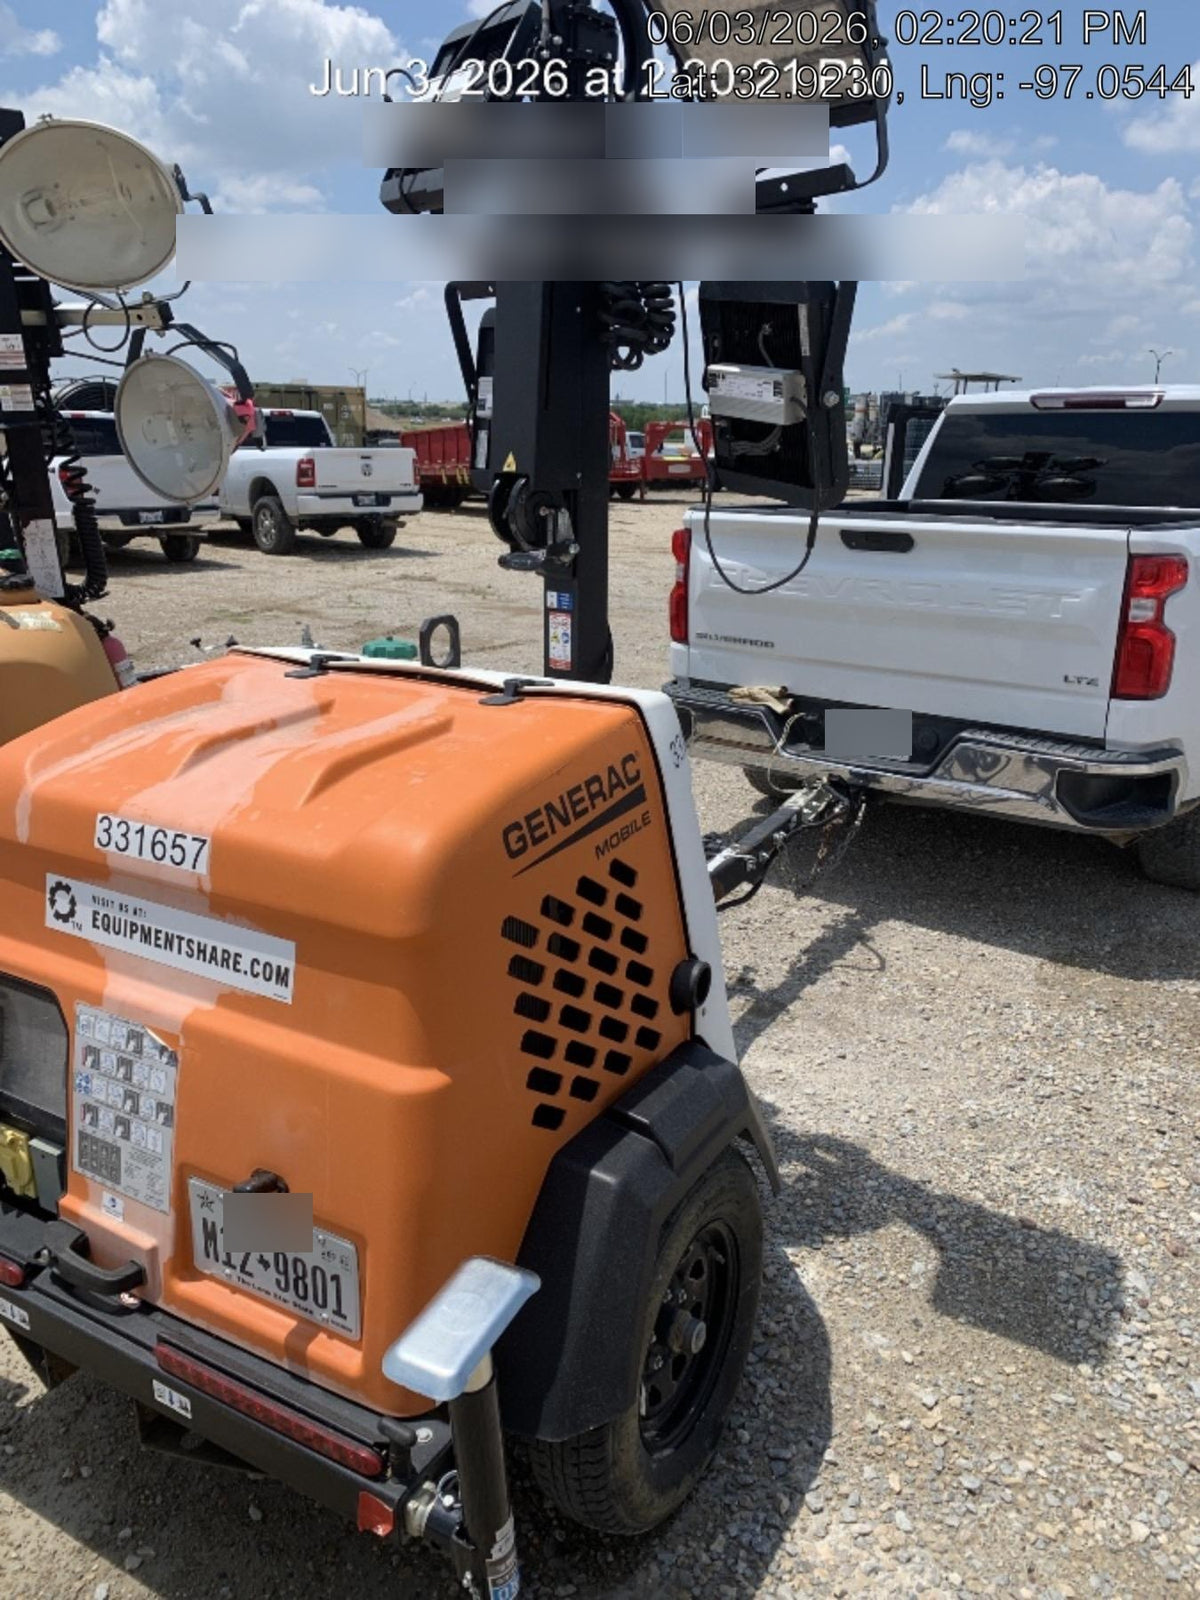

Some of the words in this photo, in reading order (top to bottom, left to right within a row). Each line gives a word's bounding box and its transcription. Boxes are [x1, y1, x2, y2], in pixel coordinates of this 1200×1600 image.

[502, 753, 641, 860] GENERAC
[594, 810, 652, 861] MOBILE
[96, 815, 208, 871] 331657
[91, 909, 290, 989] EQUIPMENTSHARE.COM
